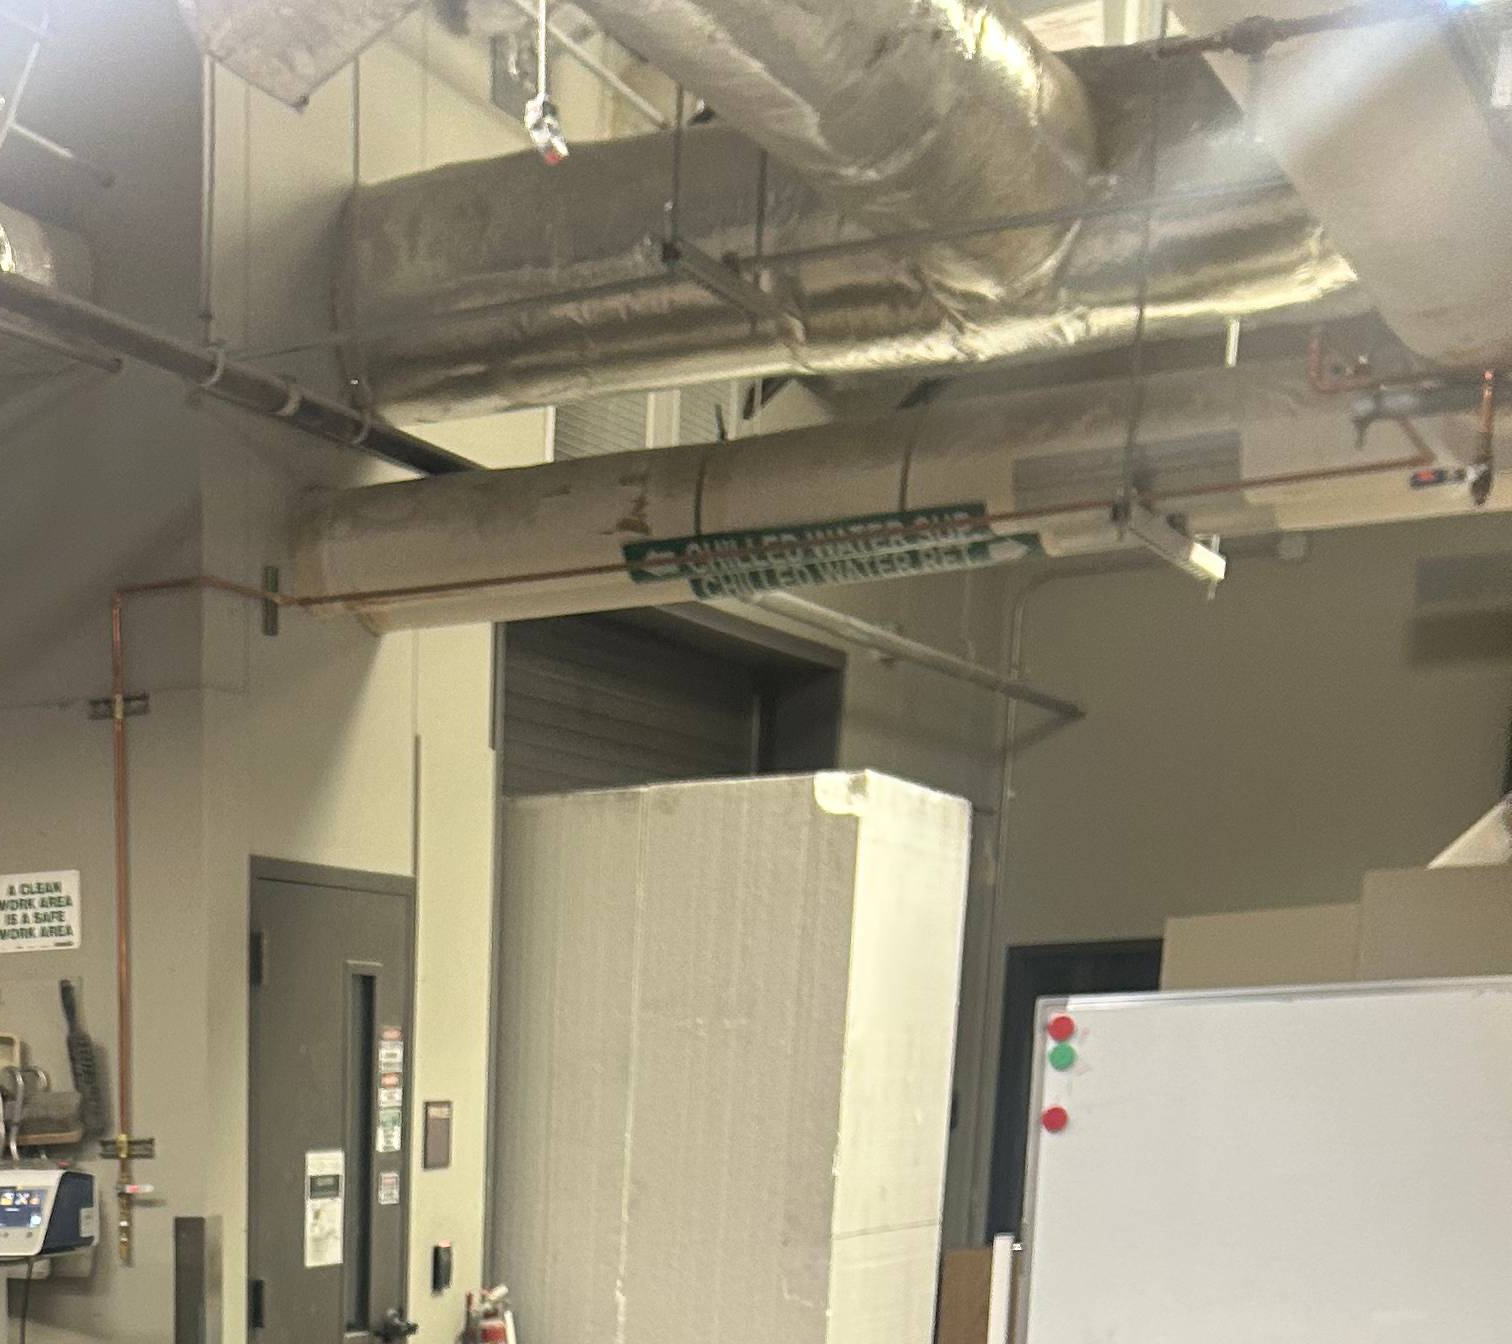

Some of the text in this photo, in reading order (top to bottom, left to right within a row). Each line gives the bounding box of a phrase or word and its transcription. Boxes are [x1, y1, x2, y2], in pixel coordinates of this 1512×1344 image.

[20, 882, 62, 895] CLEAN
[39, 896, 73, 908] AREA
[33, 910, 65, 923] SAFE
[39, 925, 73, 938] AREA
